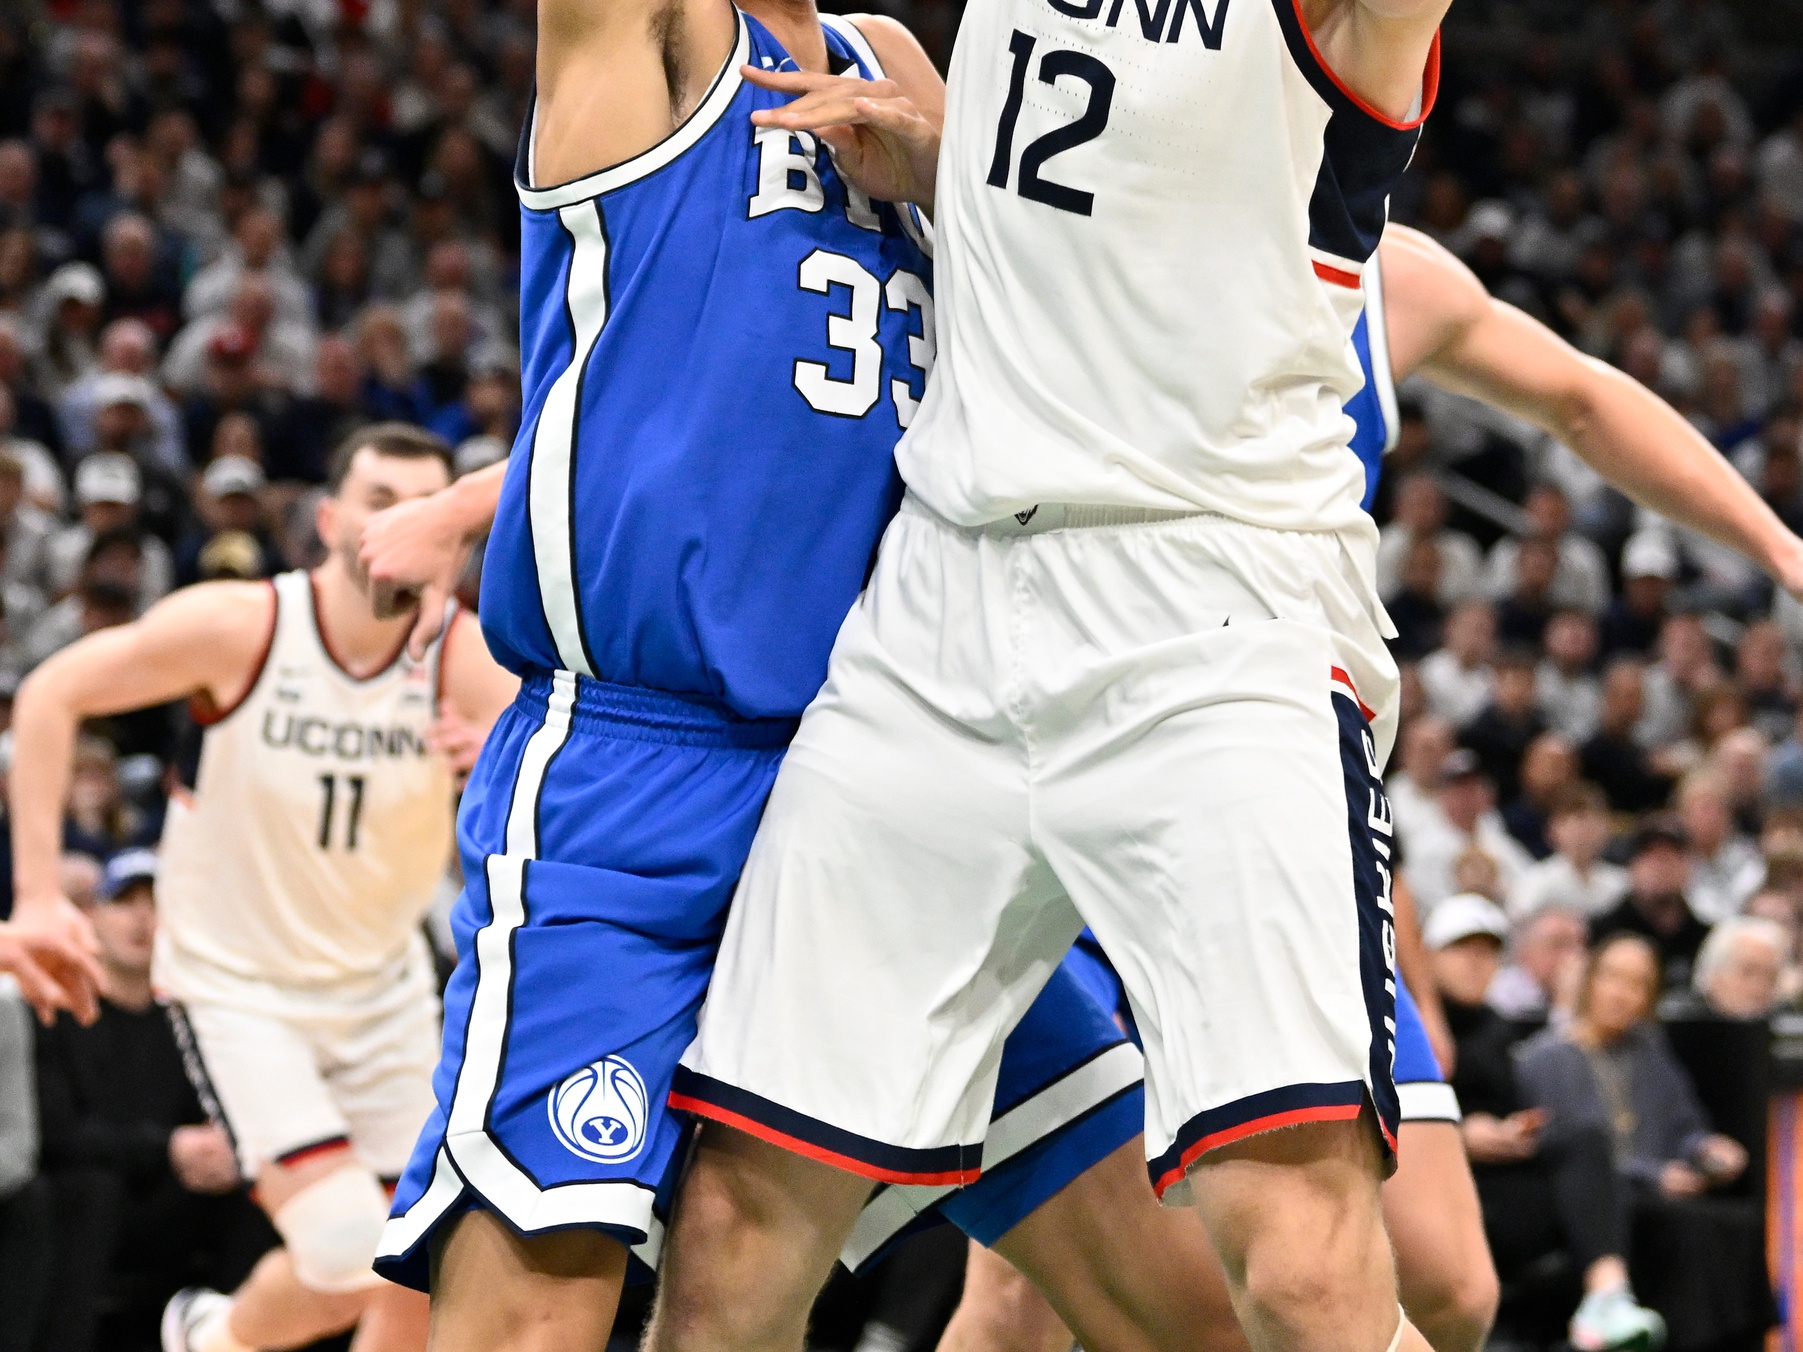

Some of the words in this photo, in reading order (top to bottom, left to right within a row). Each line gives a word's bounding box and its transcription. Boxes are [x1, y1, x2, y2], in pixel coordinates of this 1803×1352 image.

[986, 28, 1117, 217] 12
[793, 248, 937, 432] 33
[262, 710, 427, 760] UCONN
[317, 773, 370, 851] 11
[588, 1118, 622, 1144] Y
